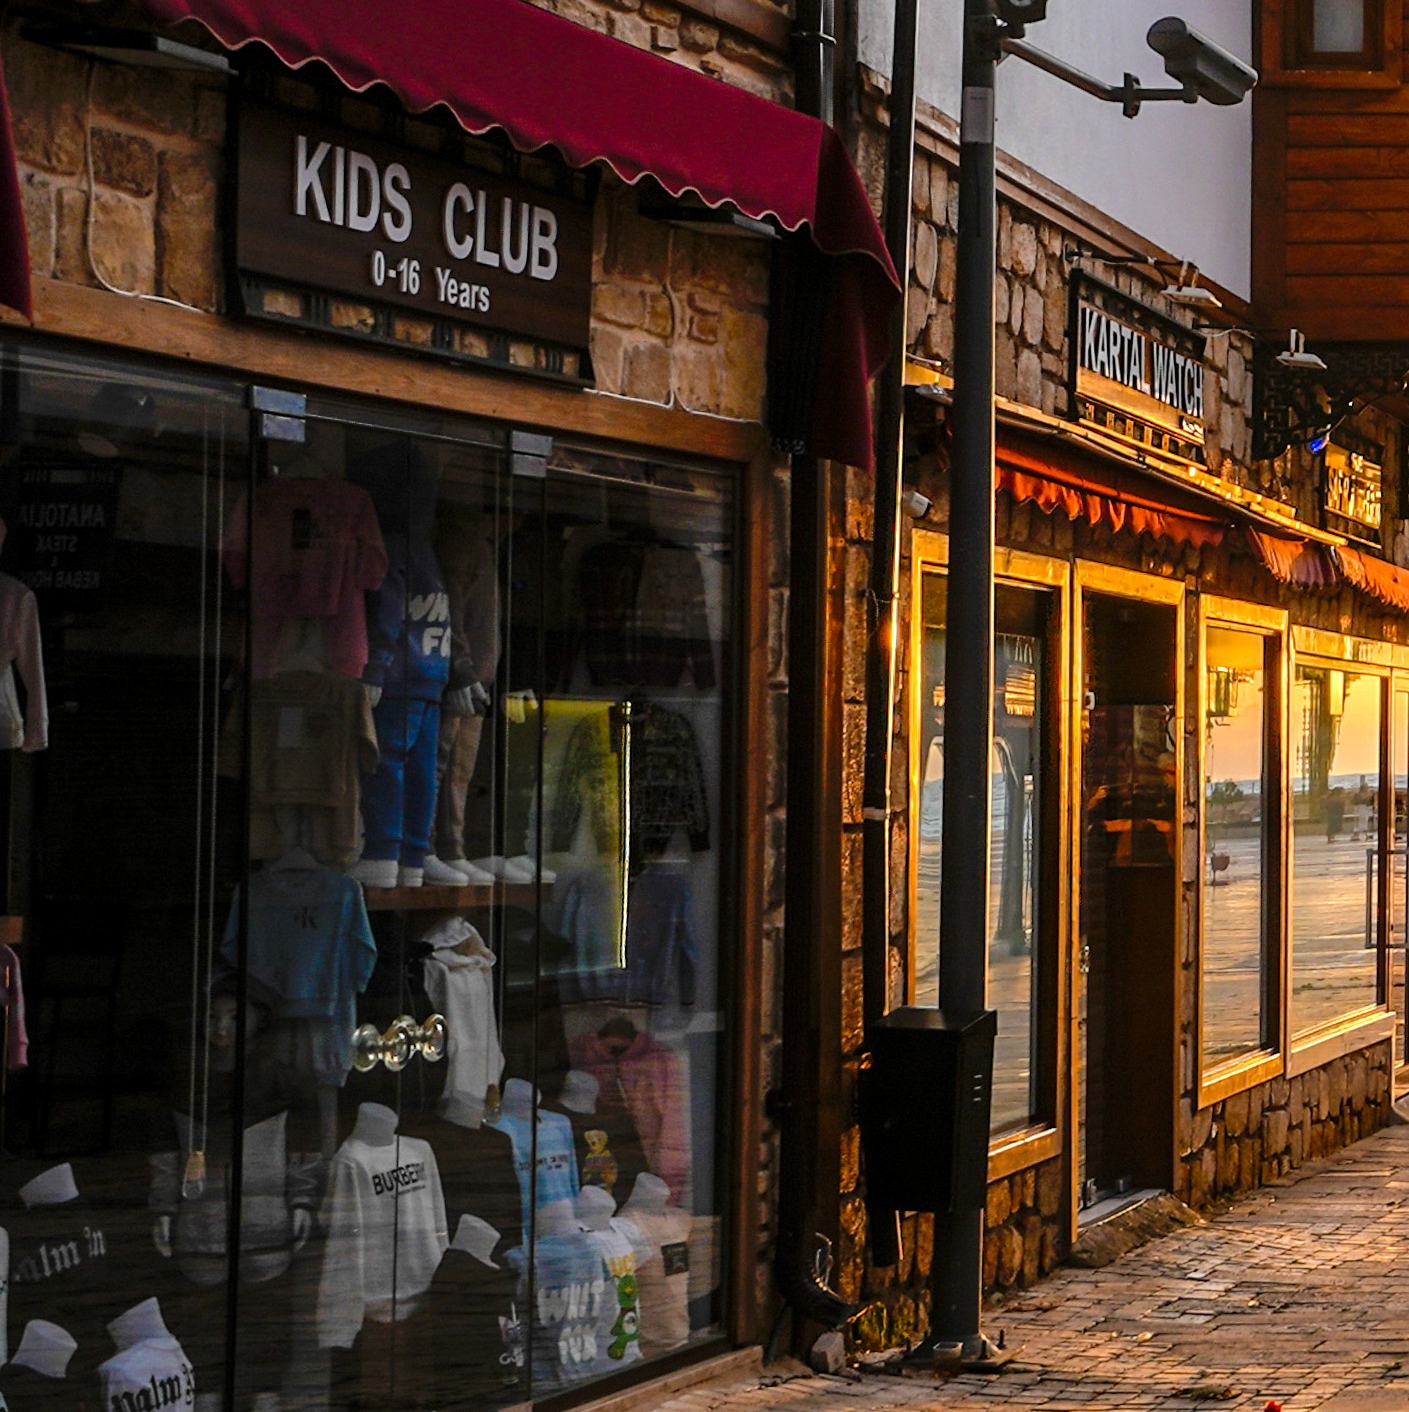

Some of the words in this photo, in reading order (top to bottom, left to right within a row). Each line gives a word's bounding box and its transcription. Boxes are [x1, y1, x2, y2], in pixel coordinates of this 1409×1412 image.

[294, 134, 414, 243] KIDS
[442, 181, 560, 281] CLUB
[370, 249, 422, 296] 0-16
[434, 265, 491, 314] Years
[1084, 307, 1152, 396] KARTAL
[1152, 341, 1205, 419] WATCH
